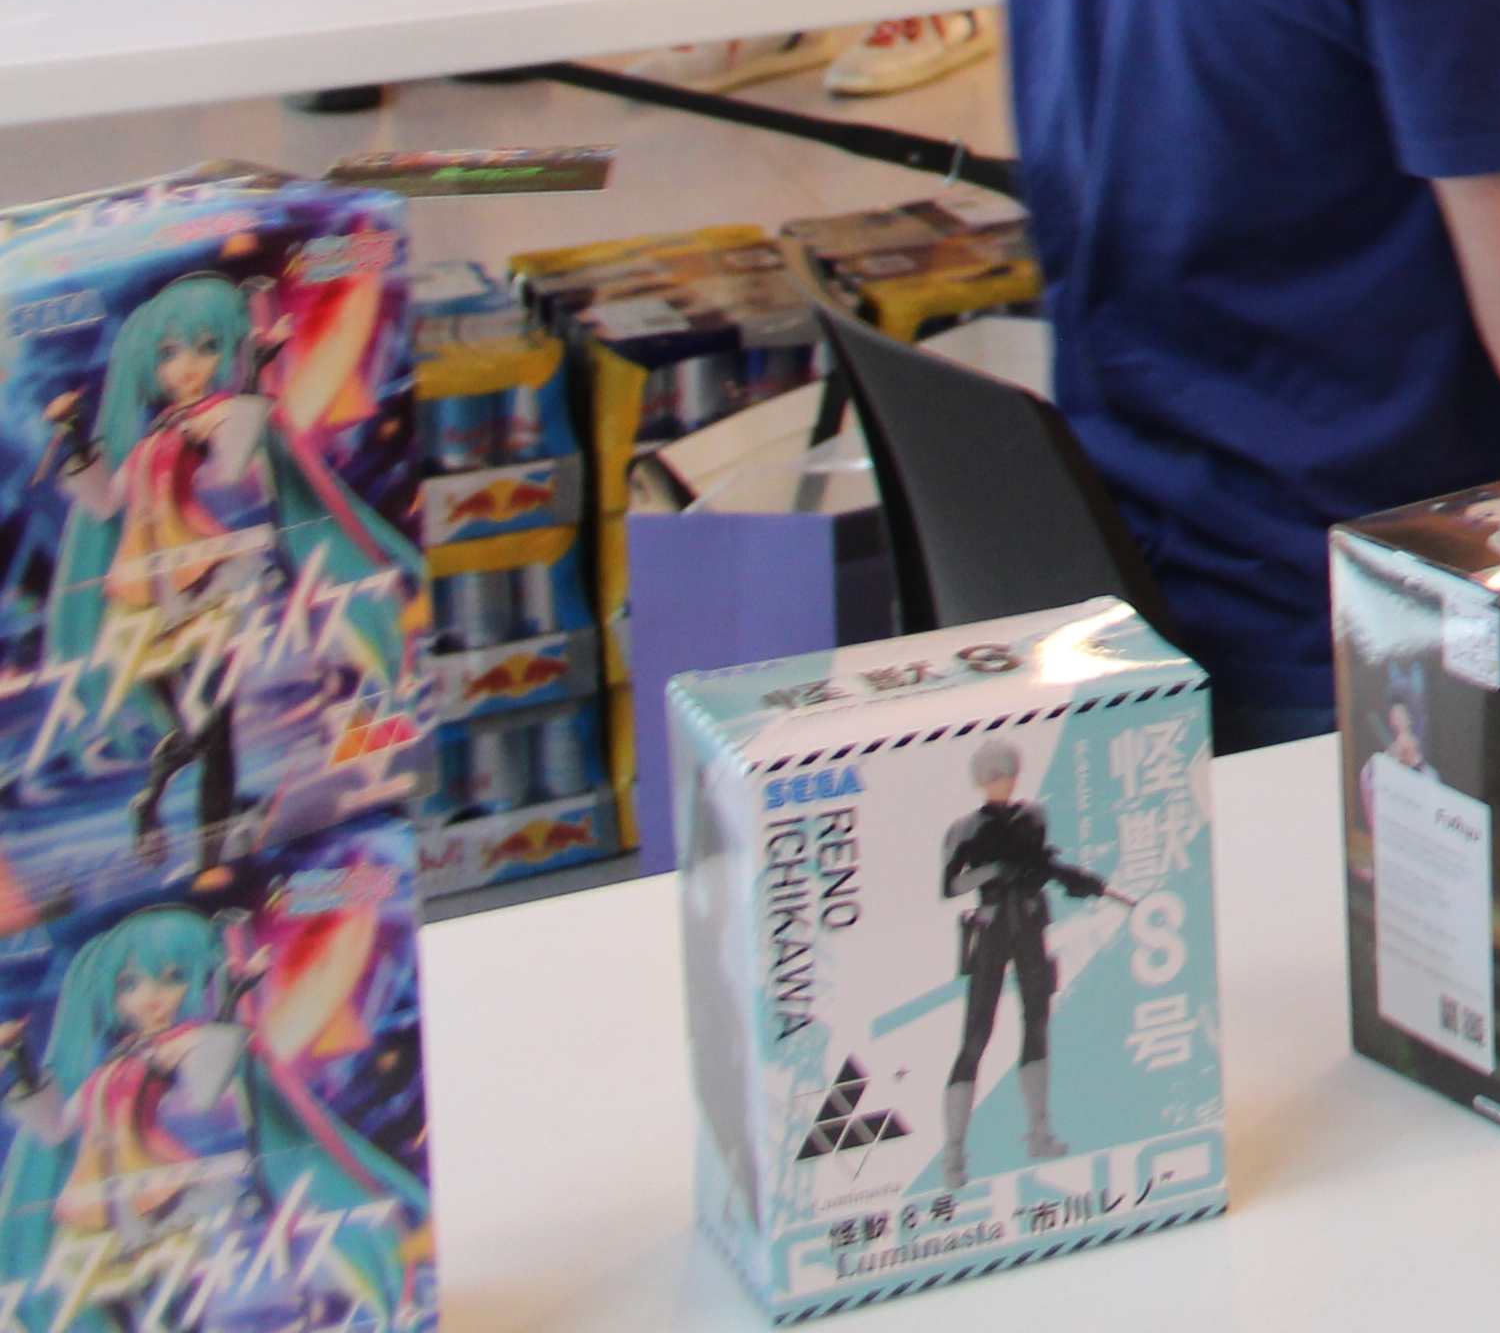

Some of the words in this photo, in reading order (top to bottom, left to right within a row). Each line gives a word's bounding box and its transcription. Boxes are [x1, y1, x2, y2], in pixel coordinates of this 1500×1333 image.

[763, 764, 865, 812] SEGA
[814, 806, 860, 931] RENO
[768, 819, 816, 1042] ICHIKAWA
[836, 1219, 1007, 1281] Luminasta
